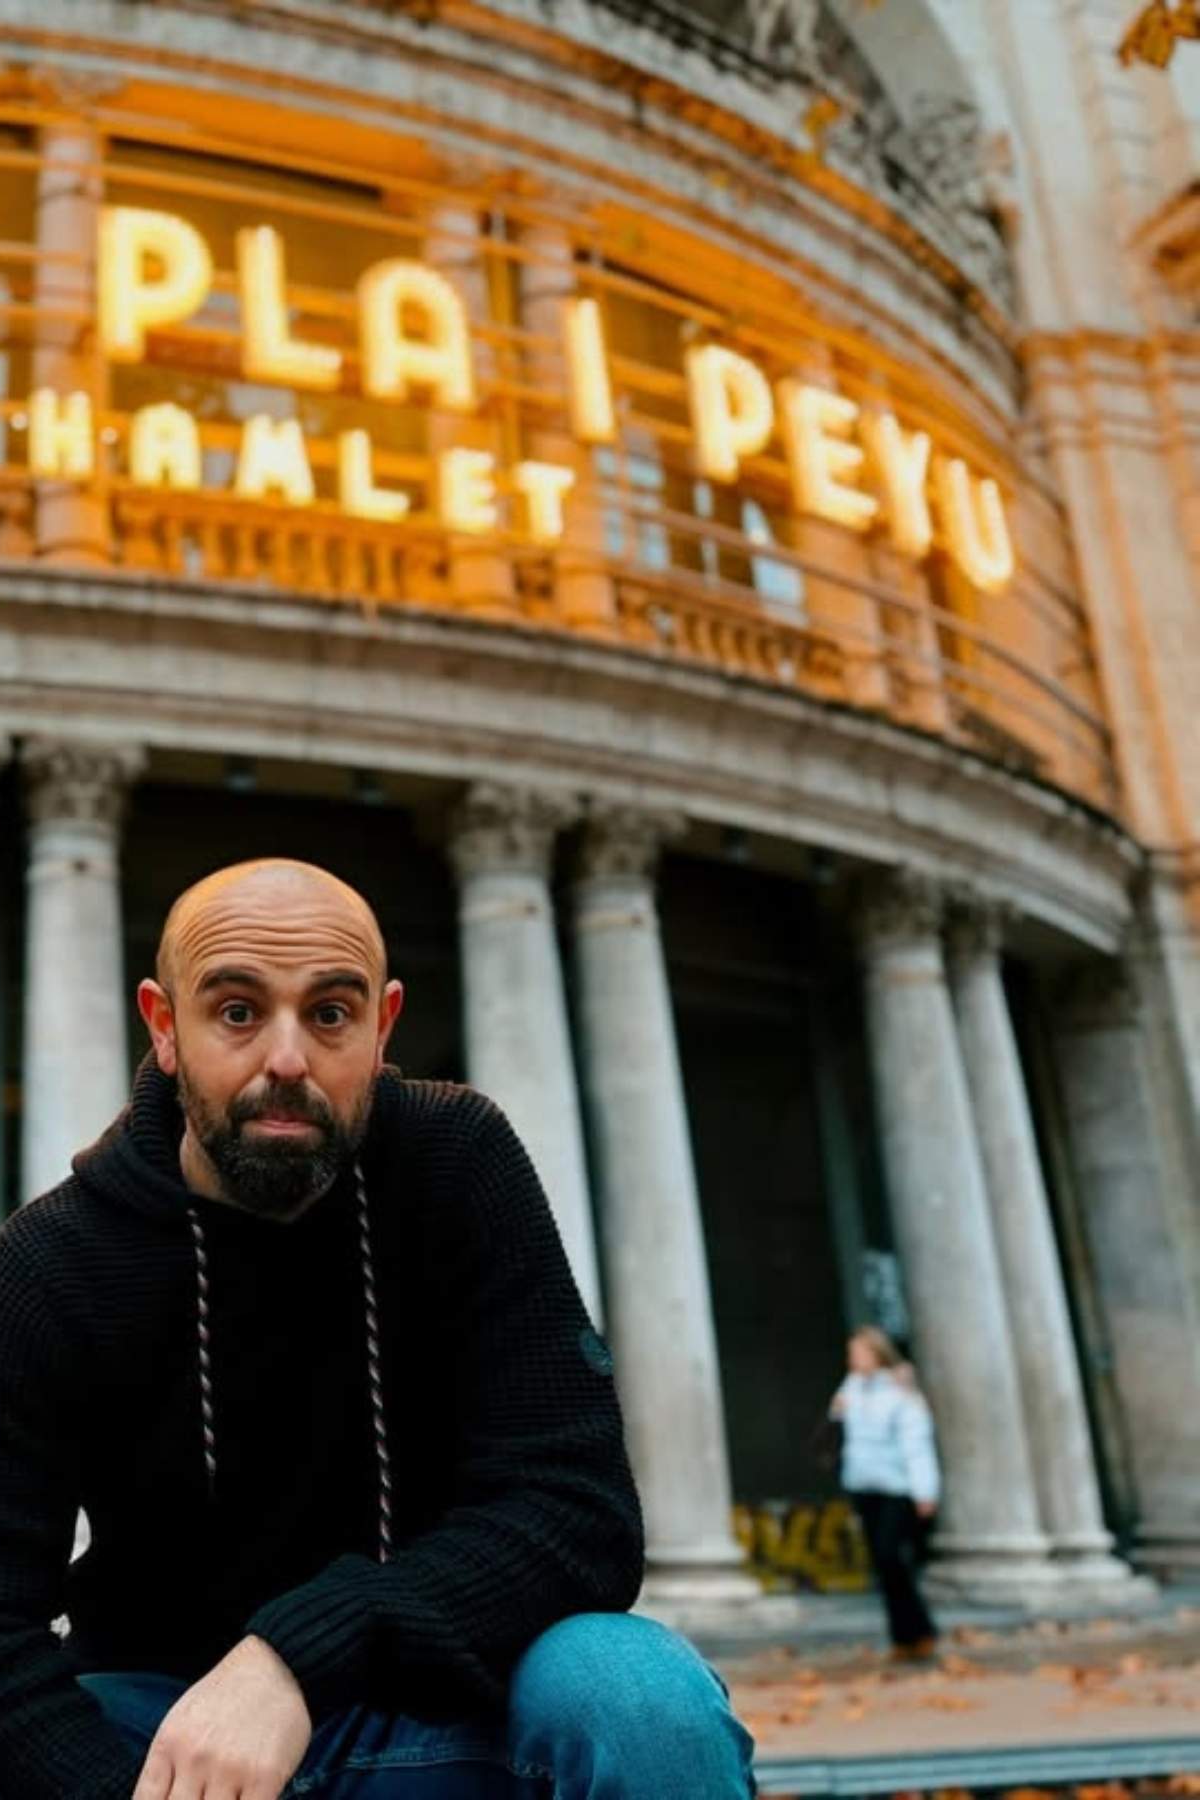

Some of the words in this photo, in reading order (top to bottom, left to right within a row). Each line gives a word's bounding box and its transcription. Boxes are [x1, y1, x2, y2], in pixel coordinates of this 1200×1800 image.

[29, 389, 574, 543] HAMLET
[98, 207, 476, 410] PLA
[566, 297, 614, 440] I
[688, 343, 1014, 592] PEYU
